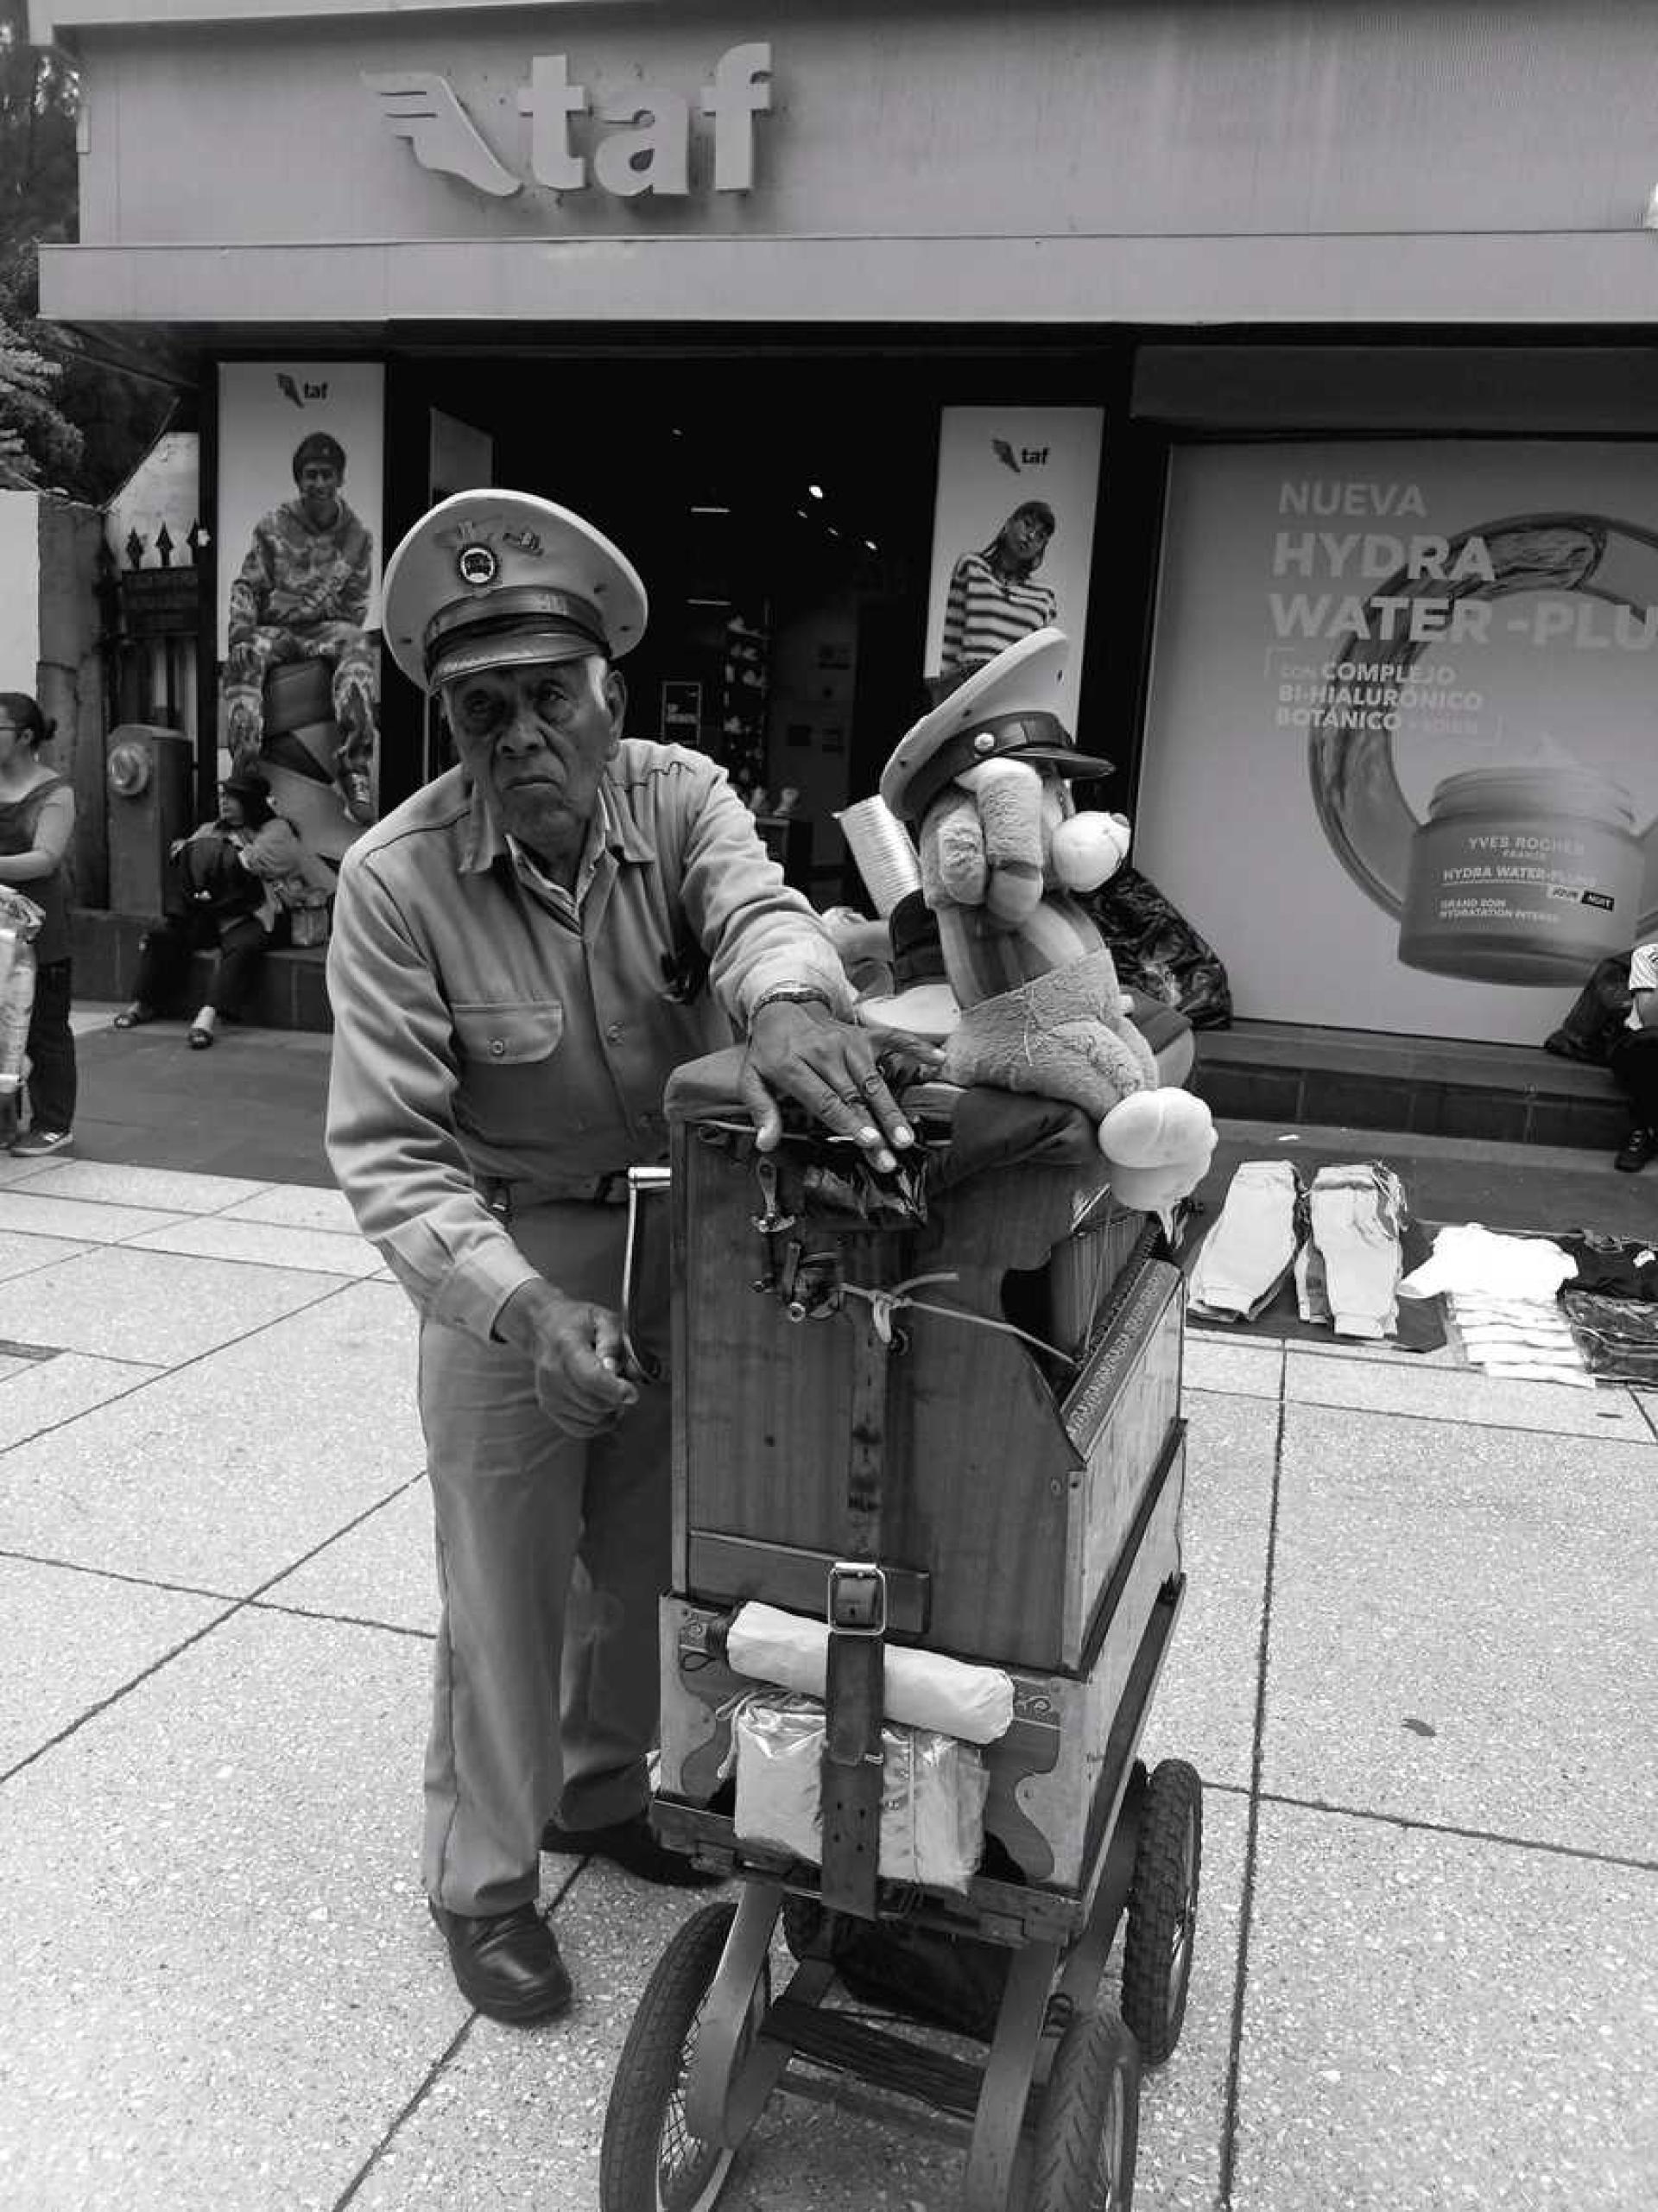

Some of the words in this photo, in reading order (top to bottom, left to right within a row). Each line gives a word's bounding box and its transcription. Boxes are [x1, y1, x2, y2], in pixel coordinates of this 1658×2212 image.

[518, 42, 772, 196] taf
[304, 381, 328, 400] taf
[1022, 447, 1051, 465] taf
[1278, 481, 1427, 517] NUEVA
[1271, 532, 1496, 581] HYDRA
[1269, 593, 1492, 643] WATER
[1321, 662, 1457, 685] COMPLEJO
[1275, 706, 1402, 731] BOTÁNICO
[1467, 836, 1509, 850] YVES
[1442, 866, 1491, 881] HYDRA
